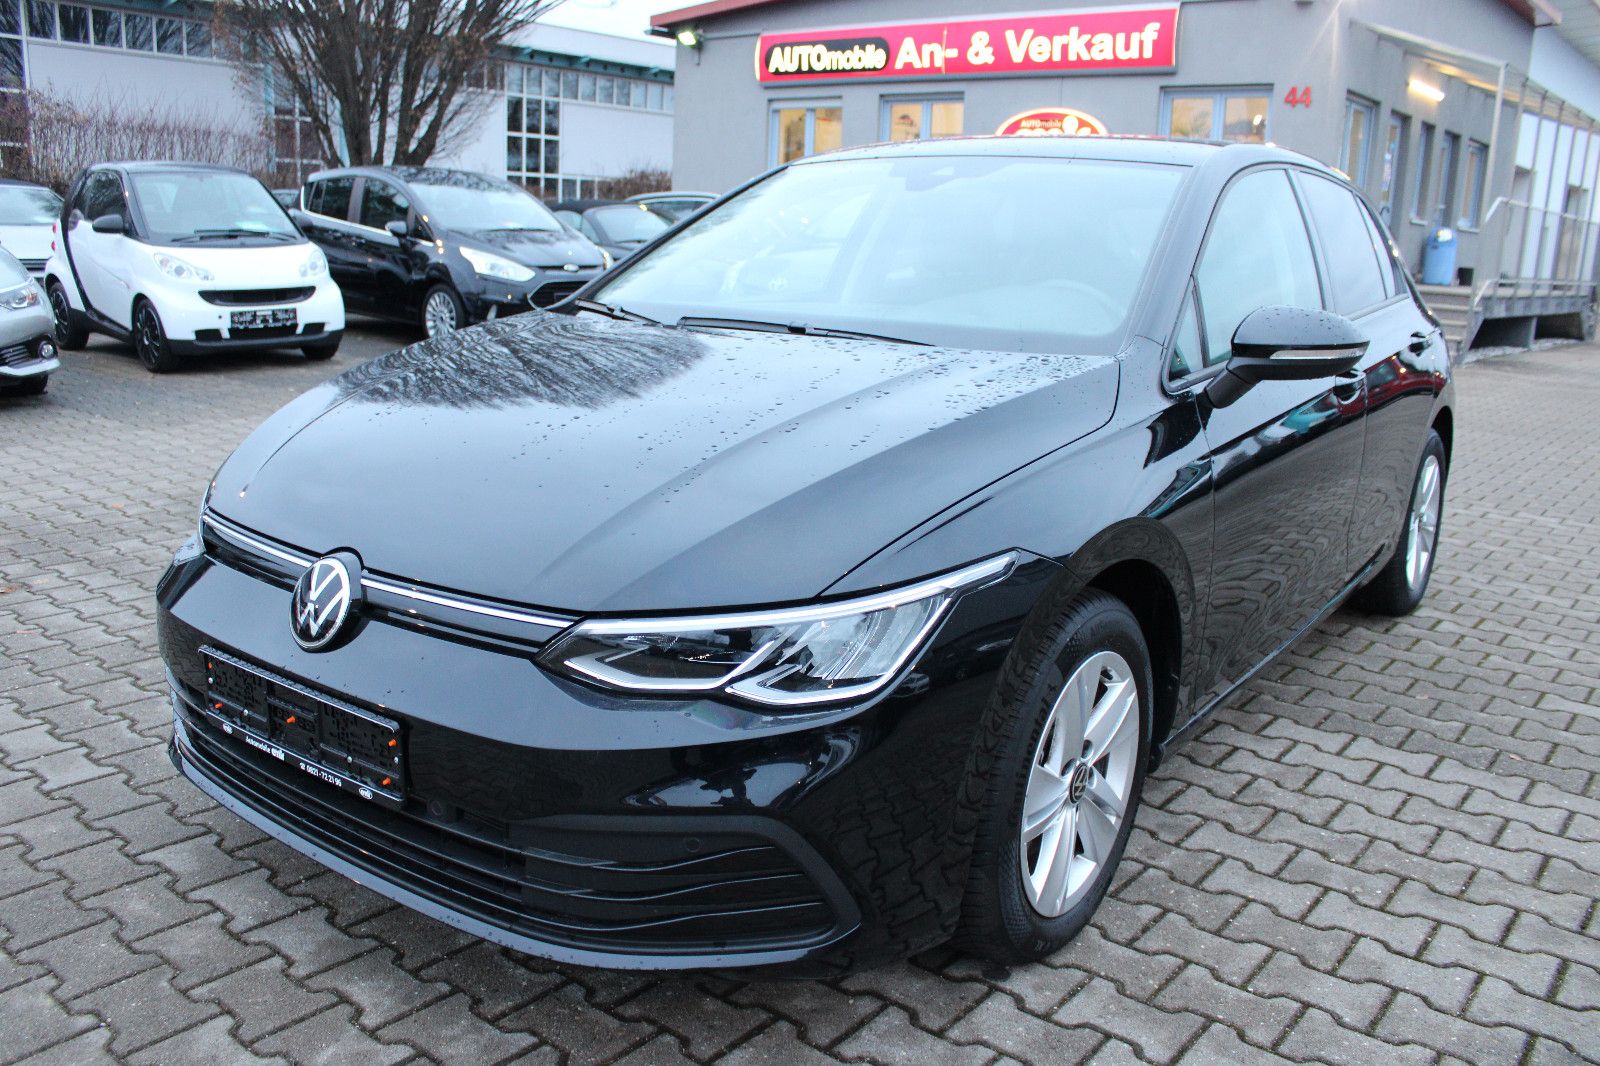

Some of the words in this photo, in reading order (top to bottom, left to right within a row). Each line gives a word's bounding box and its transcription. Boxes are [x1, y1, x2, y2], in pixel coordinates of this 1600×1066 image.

[768, 44, 887, 73] AUTOmobile
[894, 36, 958, 70] An-
[966, 31, 995, 65] &
[1004, 22, 1160, 63] Verkauf
[1284, 86, 1311, 108] 44
